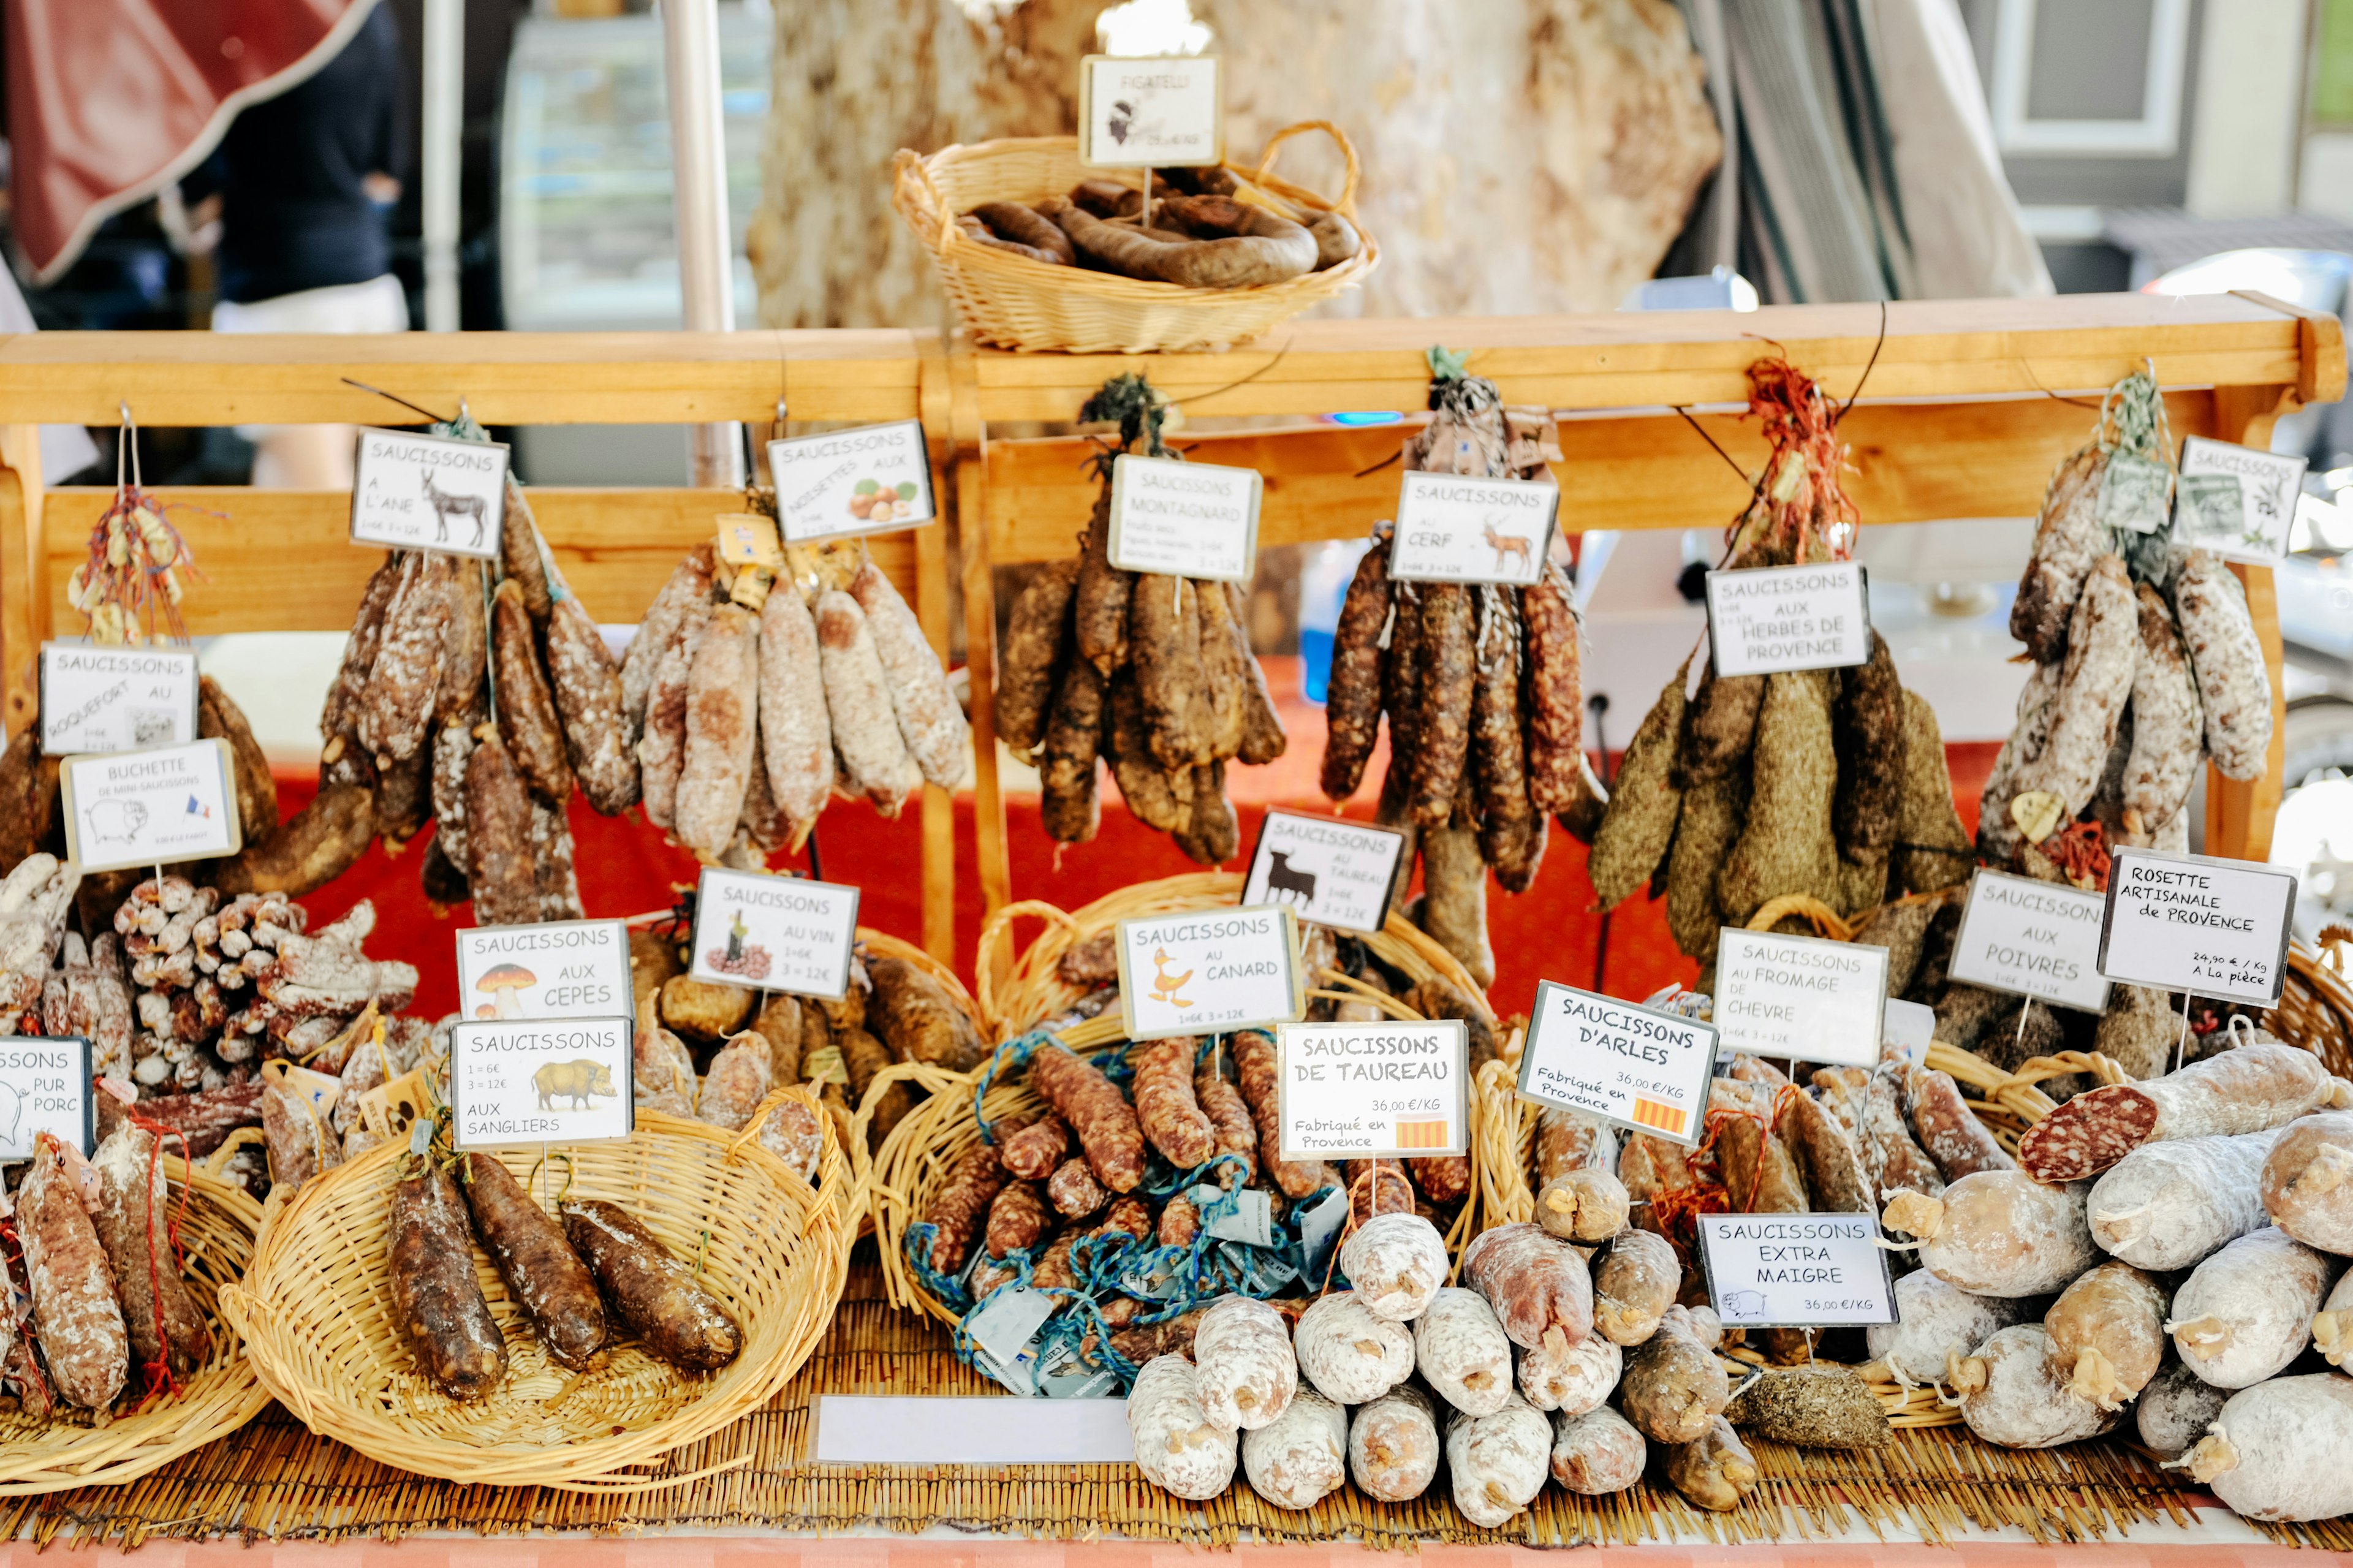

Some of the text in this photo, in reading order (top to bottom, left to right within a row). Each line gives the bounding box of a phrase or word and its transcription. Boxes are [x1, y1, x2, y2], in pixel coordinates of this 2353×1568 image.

[371, 443, 493, 471] SAUCISSONS
[783, 432, 905, 463] SAUCISSONS
[873, 455, 906, 469] AUX
[2195, 450, 2292, 480] SAUCISSONS
[369, 477, 377, 488] A
[789, 460, 857, 513] NOISETTES
[1142, 473, 1232, 496] SAUCISSONS
[1415, 485, 1540, 507] SAUCISSONS
[1131, 498, 1240, 521] MONTAGNARD
[1409, 532, 1452, 547] CERF
[1722, 572, 1849, 599] SAUCISSONS
[1776, 602, 1808, 616] AUX
[1743, 615, 1844, 640] HERBES DE
[1748, 637, 1843, 660] PROVENCE
[57, 655, 184, 674] SAUCISSONS
[150, 686, 171, 699] AU
[48, 679, 129, 737] ROQUEFORT
[108, 757, 186, 779] BUCHETTE
[99, 787, 110, 796] DE
[1273, 821, 1388, 854] SAUCISSONS
[1333, 854, 1351, 863] AU
[1330, 866, 1385, 885] TAUREAU
[2132, 867, 2210, 888] ROSETTE
[723, 887, 830, 915] SAUCISSONS
[1983, 885, 2102, 925] SAUCISSON
[2121, 885, 2221, 909] ARTISANALE
[2139, 904, 2254, 931] de PROVENCE
[474, 929, 609, 955] SAUCISSONS
[783, 925, 835, 944] AU VIN
[1136, 918, 1270, 946] SAUCISSONS
[2022, 926, 2059, 945] AUX
[1206, 950, 1222, 961] AU
[1742, 945, 1862, 973] SAUCISSONS
[1985, 944, 2079, 980] POIVRES
[2194, 952, 2224, 964] 24,90
[2229, 958, 2238, 966] €
[559, 964, 596, 980] AUX
[1207, 961, 1278, 981] CANARD
[1732, 968, 1840, 992] AU FROMAGE
[2192, 966, 2265, 986] A La pièce
[545, 985, 612, 1006] CEPES
[1730, 983, 1746, 995] DE
[1728, 1000, 1795, 1022] CHEVRE
[1563, 998, 1694, 1048] SAUCISSONS
[471, 1031, 615, 1053] SAUCISSONS
[1303, 1036, 1440, 1056] SAUCISSONS
[1579, 1026, 1669, 1065] D'ARLES
[468, 1065, 473, 1074] 1
[487, 1064, 499, 1074] 6€
[1295, 1061, 1448, 1081] DE TAUREAU
[34, 1078, 65, 1091] PUR
[468, 1080, 474, 1089] 3
[488, 1079, 506, 1089] 12€
[1537, 1067, 1627, 1100] Fabriqué en
[1616, 1072, 1649, 1089] 36,00
[34, 1098, 77, 1111] PORC
[1372, 1100, 1404, 1113] 36,00
[1542, 1083, 1609, 1111] Provence
[468, 1103, 501, 1116] AUX
[468, 1119, 559, 1135] SANGLIERS
[1295, 1116, 1362, 1137] Fabriqué
[1302, 1136, 1372, 1148] Provence
[1719, 1224, 1865, 1240] SAUCISSONS
[1760, 1246, 1831, 1261] EXTRA
[1757, 1268, 1843, 1283] MAIGRE
[1805, 1300, 1838, 1311] 36,00
